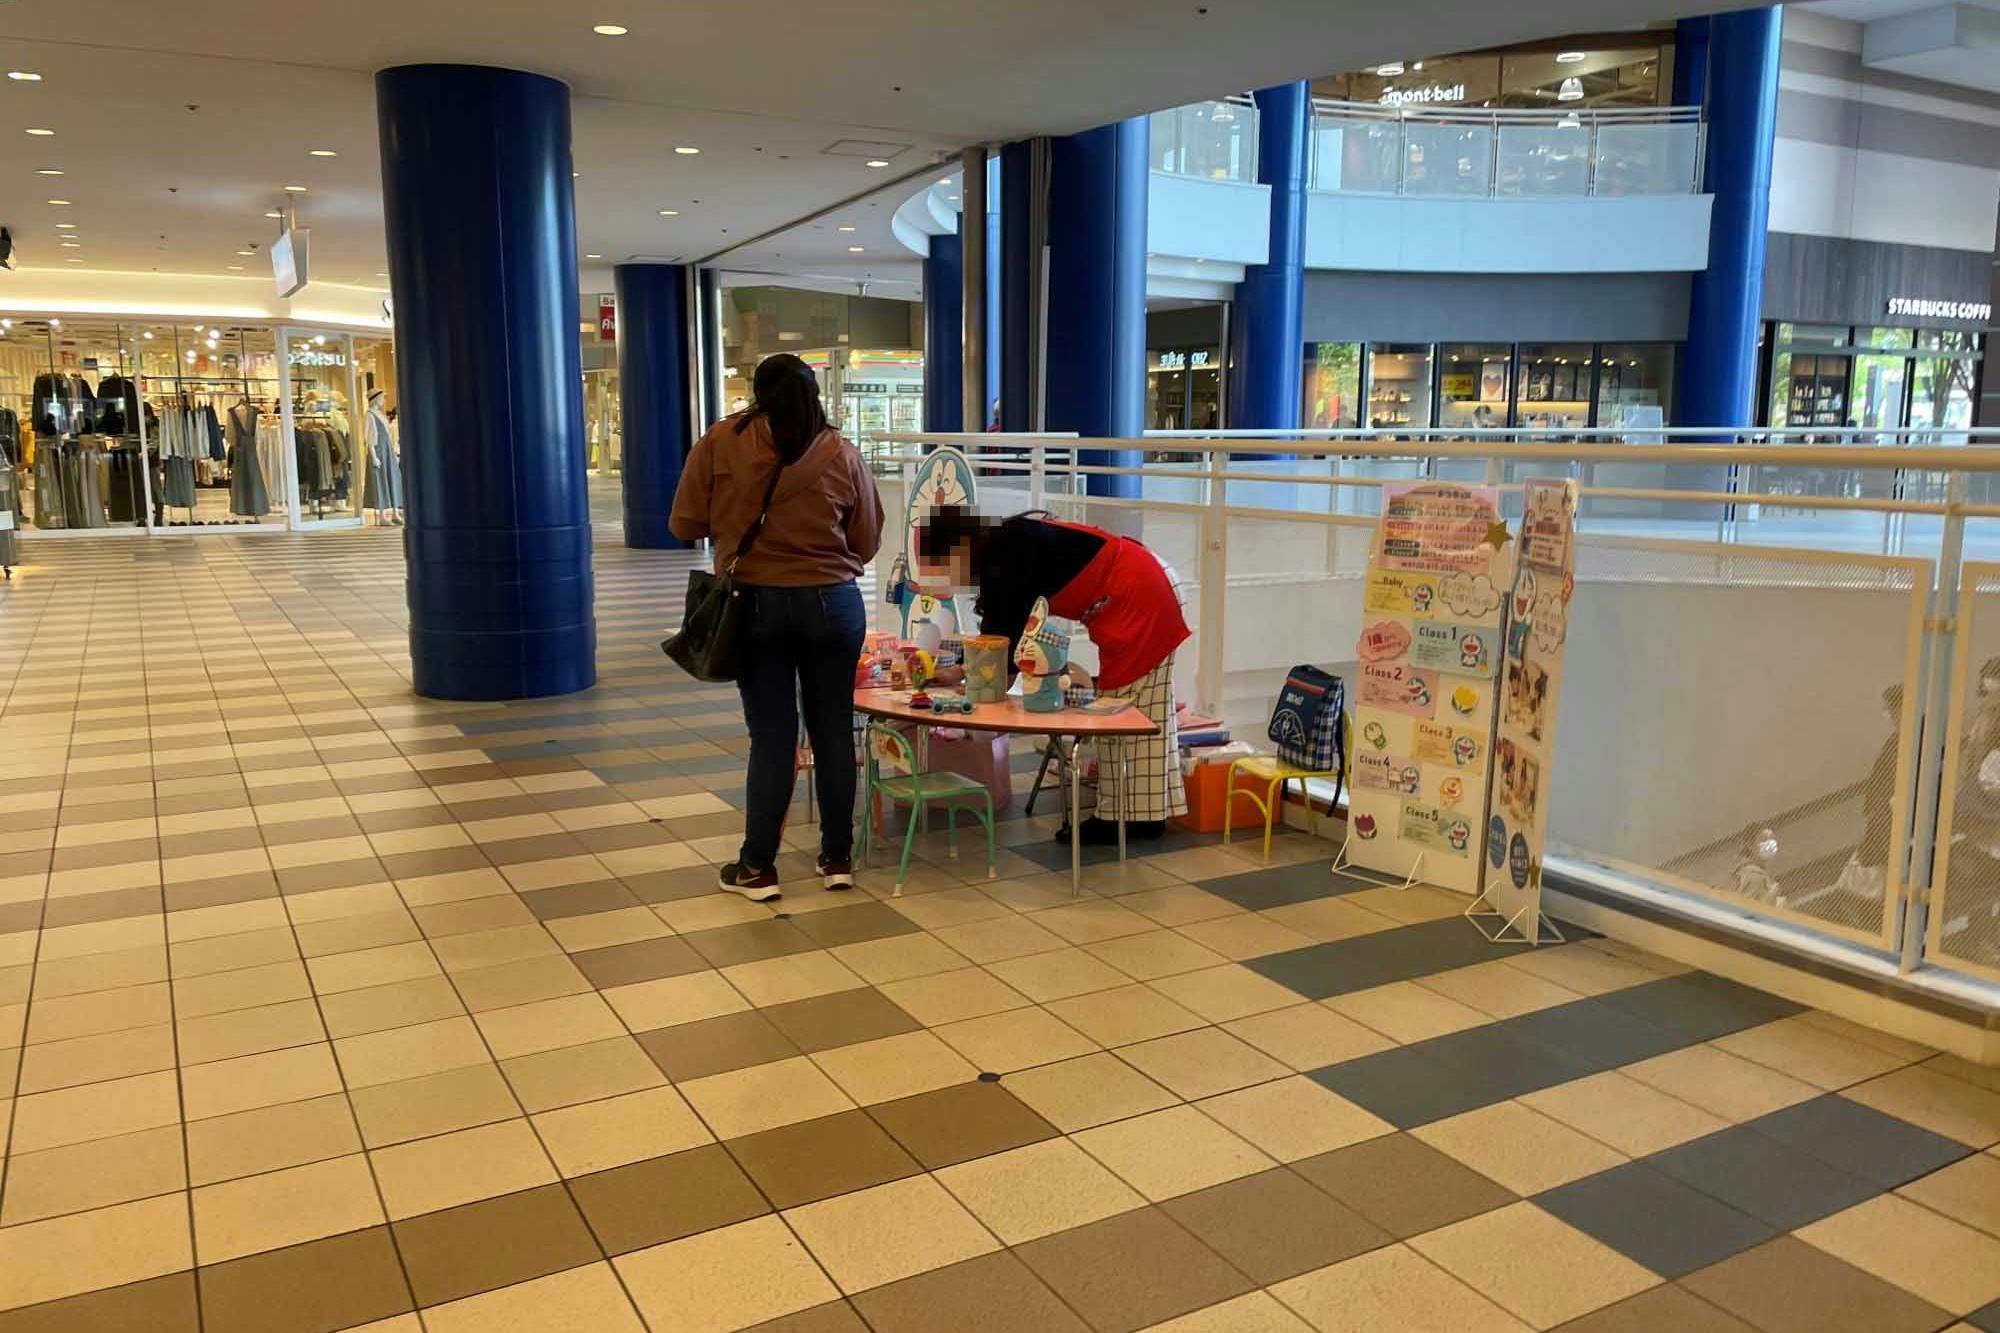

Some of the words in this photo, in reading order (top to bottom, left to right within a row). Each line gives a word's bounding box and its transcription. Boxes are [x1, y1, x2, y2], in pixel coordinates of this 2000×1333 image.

[1888, 298, 1957, 317] STARBUCKS
[1419, 626, 1447, 639] Class
[1451, 626, 1457, 640] 1
[1364, 665, 1392, 679] Class
[1394, 667, 1402, 680] 2
[1419, 724, 1443, 737] Class
[1445, 726, 1453, 739] 3
[1359, 755, 1381, 766] Class
[1383, 756, 1390, 767] 4
[1406, 806, 1430, 820] Class
[1431, 809, 1439, 821] 5
